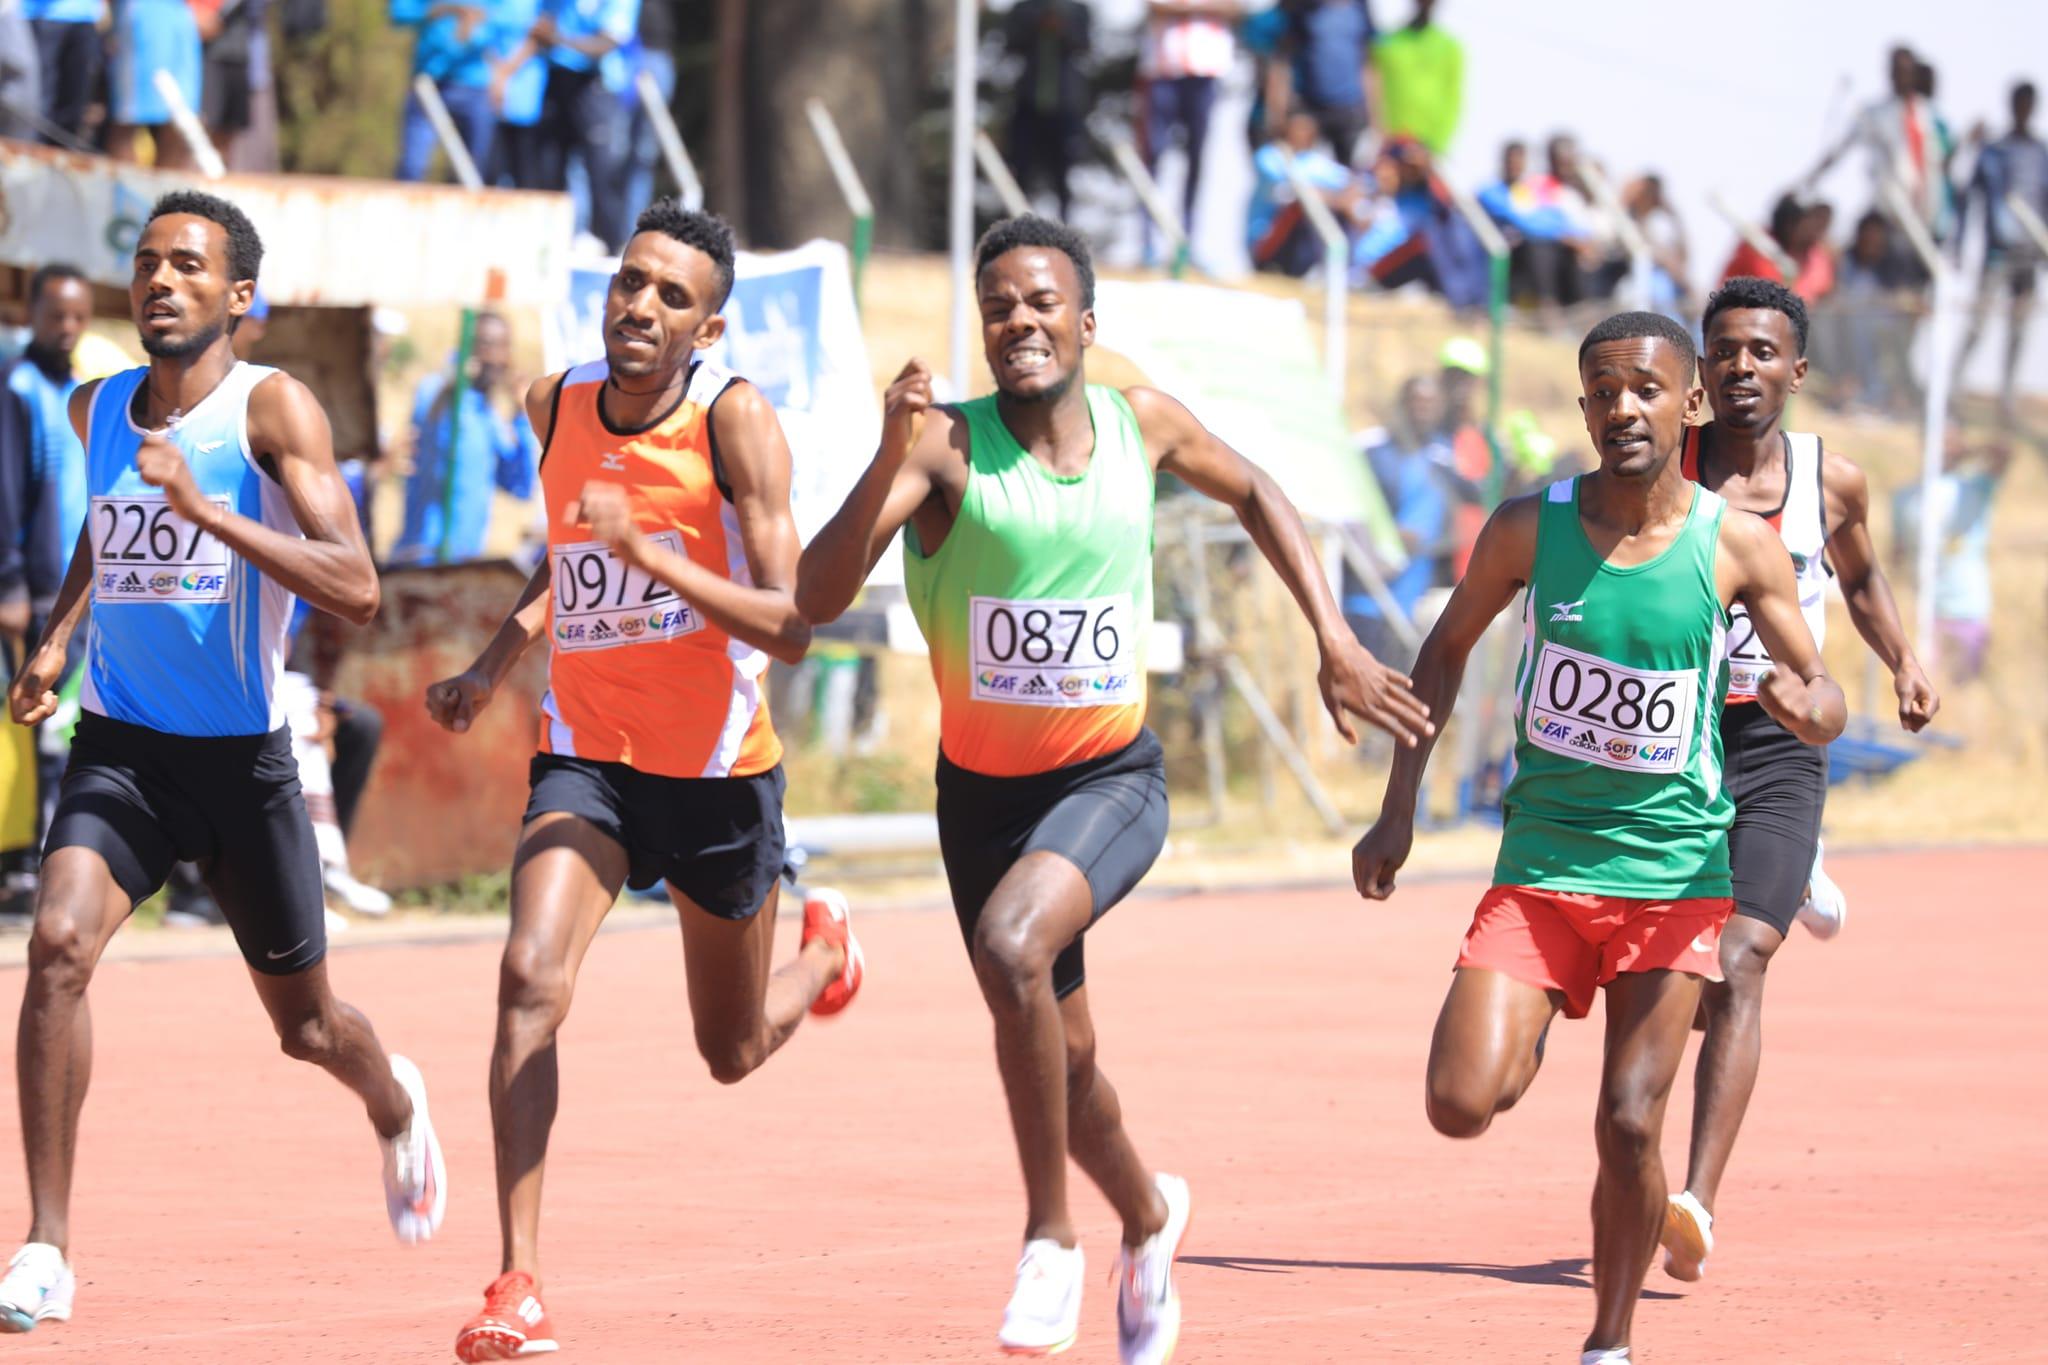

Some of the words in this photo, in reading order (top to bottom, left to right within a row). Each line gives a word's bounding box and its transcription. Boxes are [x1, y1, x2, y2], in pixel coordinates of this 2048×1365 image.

[148, 576, 178, 590] SOFI
[194, 575, 225, 590] EAF
[617, 618, 646, 633] SOFI
[661, 608, 689, 629] EAF
[987, 606, 1119, 663] 0876
[989, 675, 1018, 691] EAF
[1056, 679, 1089, 692] SOFI
[1549, 658, 1676, 733] 0286
[1542, 721, 1572, 741] EAF
[1569, 738, 1601, 753] adidas
[1603, 741, 1638, 755] SOFI
[1649, 746, 1677, 761] EAF
